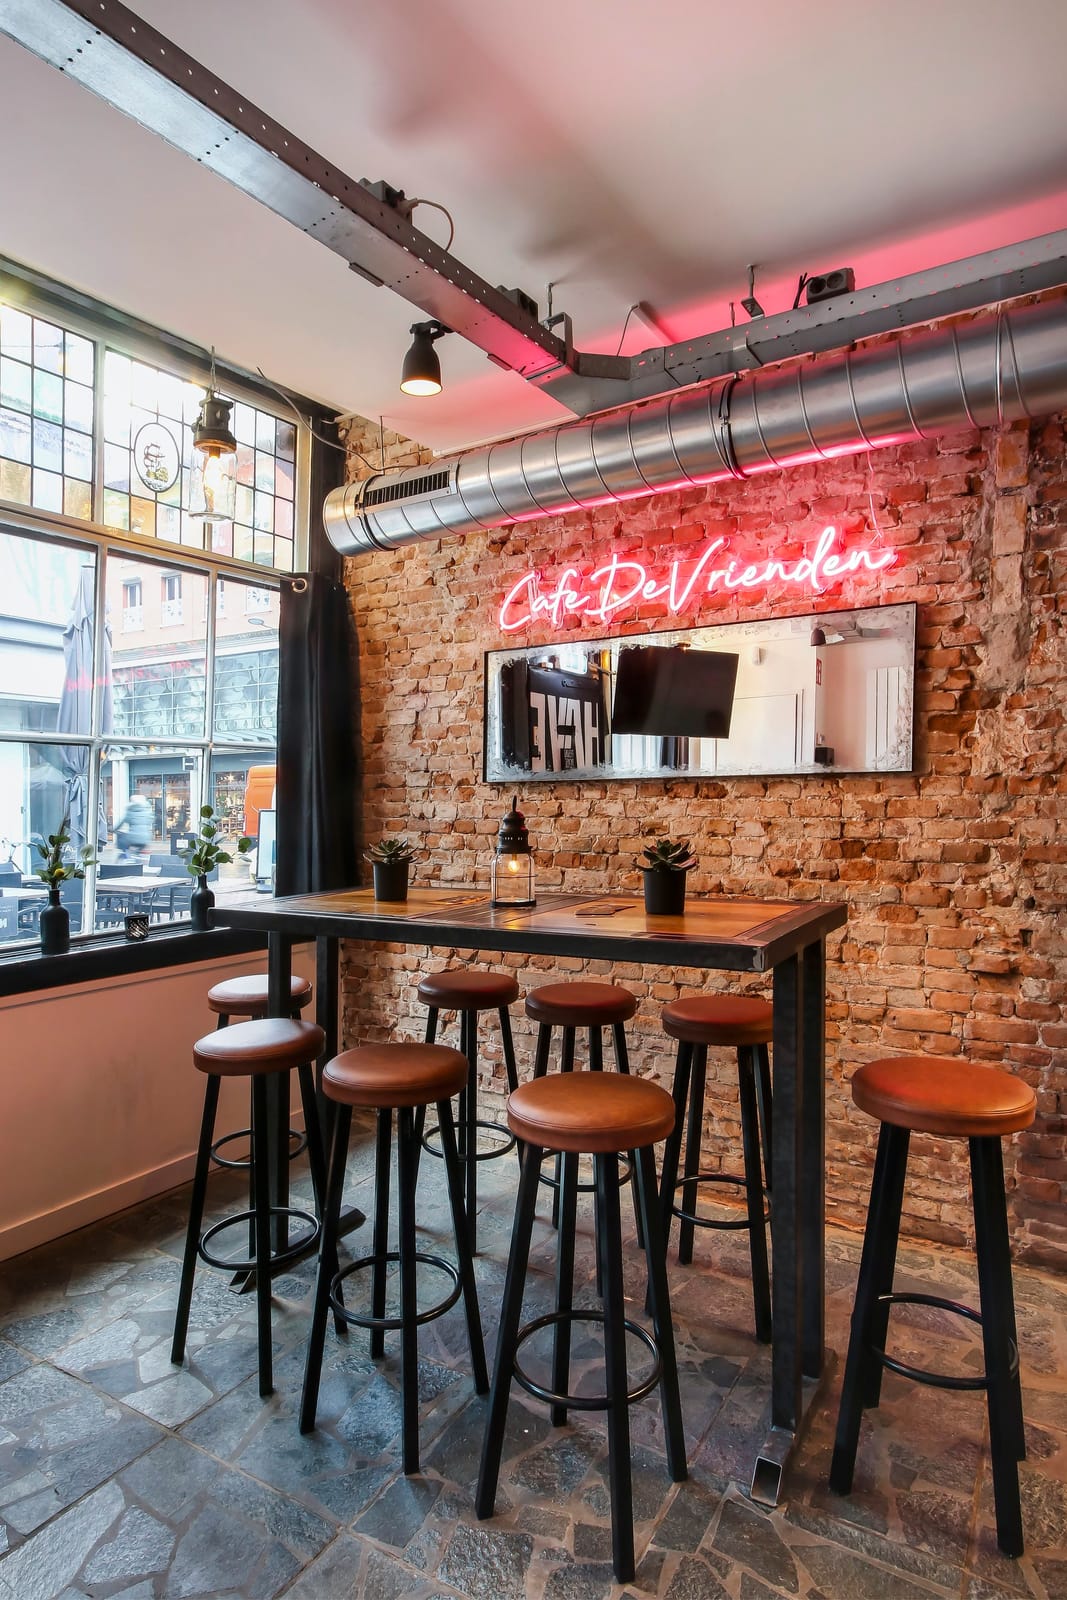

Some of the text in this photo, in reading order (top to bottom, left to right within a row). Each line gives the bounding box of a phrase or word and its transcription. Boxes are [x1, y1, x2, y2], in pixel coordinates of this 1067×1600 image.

[499, 525, 894, 631] Cafe De Vrienden
